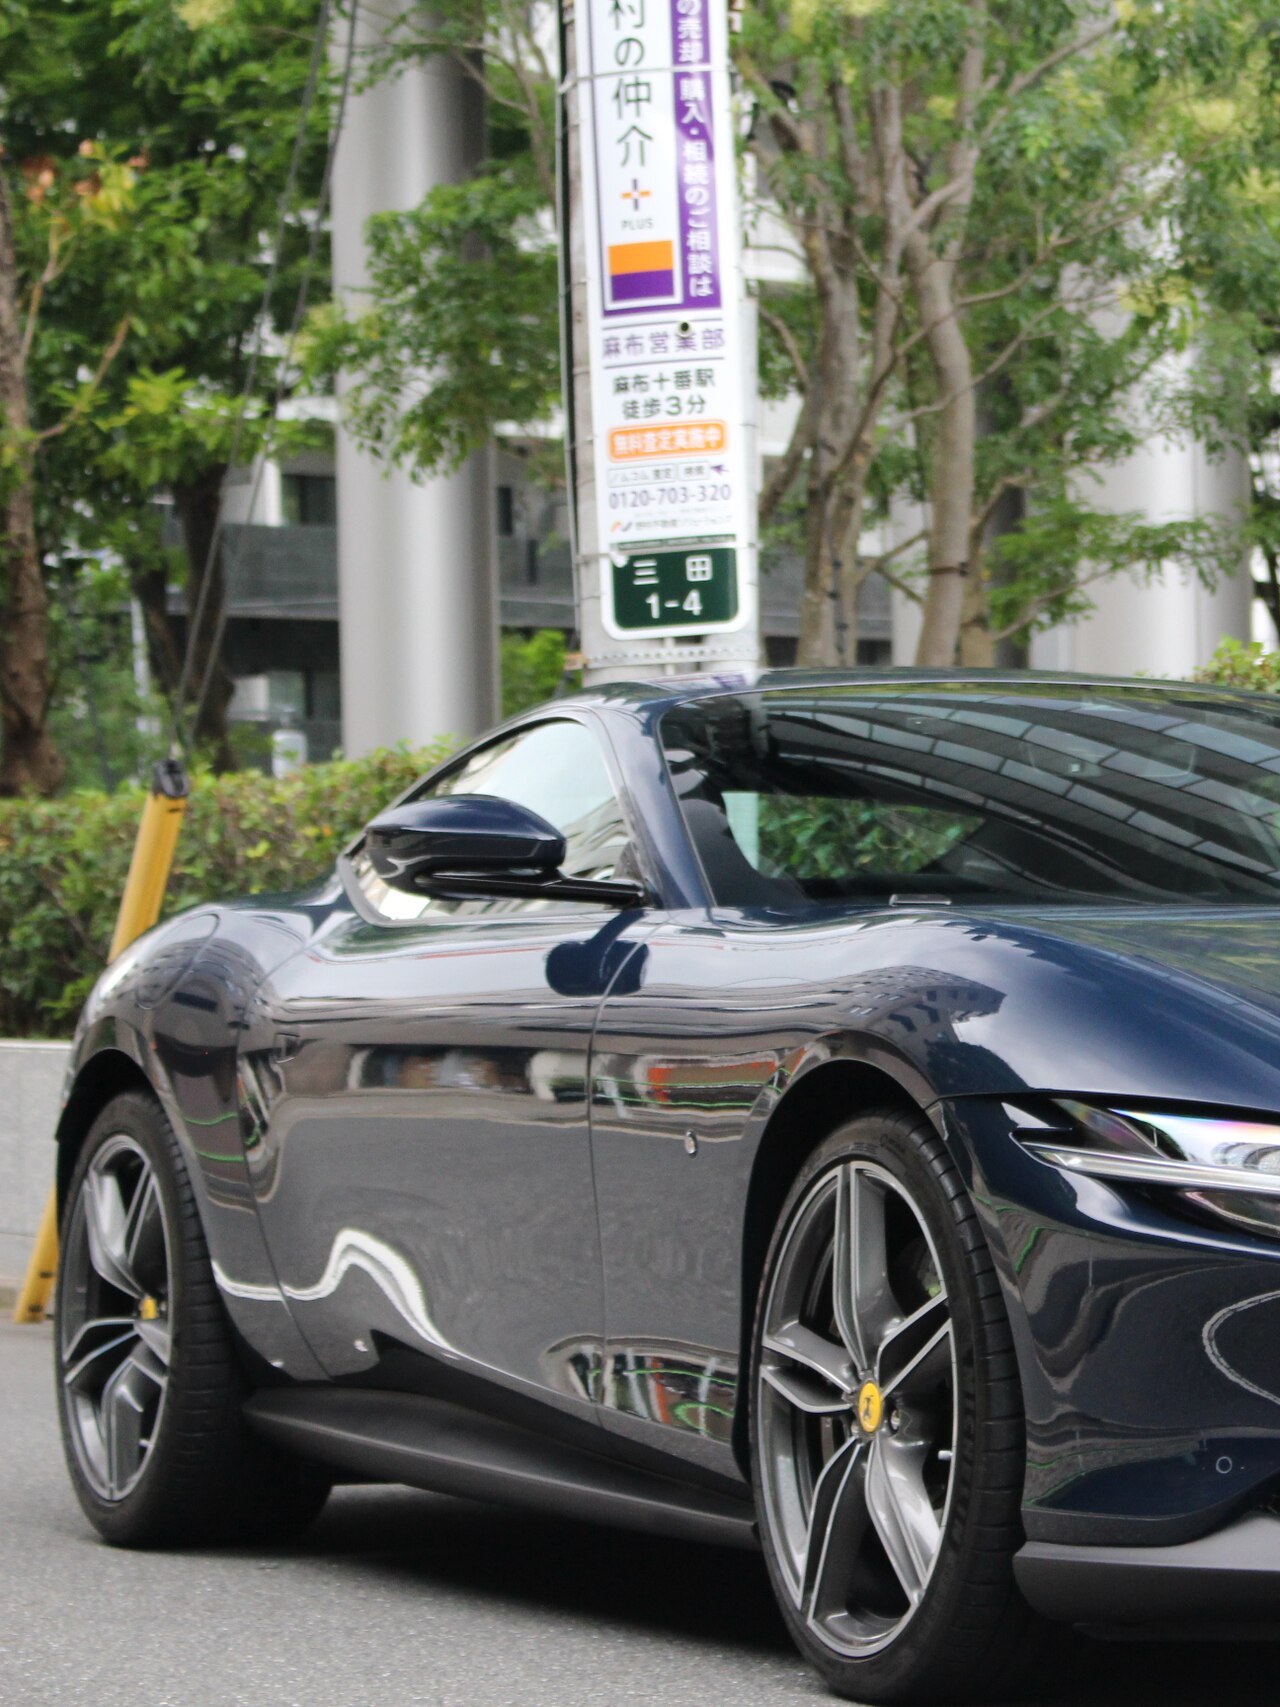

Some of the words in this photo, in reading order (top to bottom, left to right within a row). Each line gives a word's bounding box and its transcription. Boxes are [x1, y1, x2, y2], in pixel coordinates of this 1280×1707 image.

[621, 218, 654, 230] PLUS
[602, 328, 725, 358] 麻布営業部
[613, 368, 715, 395] 麻布十番駅
[623, 395, 706, 419] 徒歩3分
[609, 484, 731, 509] 0120-703-320
[633, 554, 712, 585] 三田
[646, 589, 703, 618] 1-4
